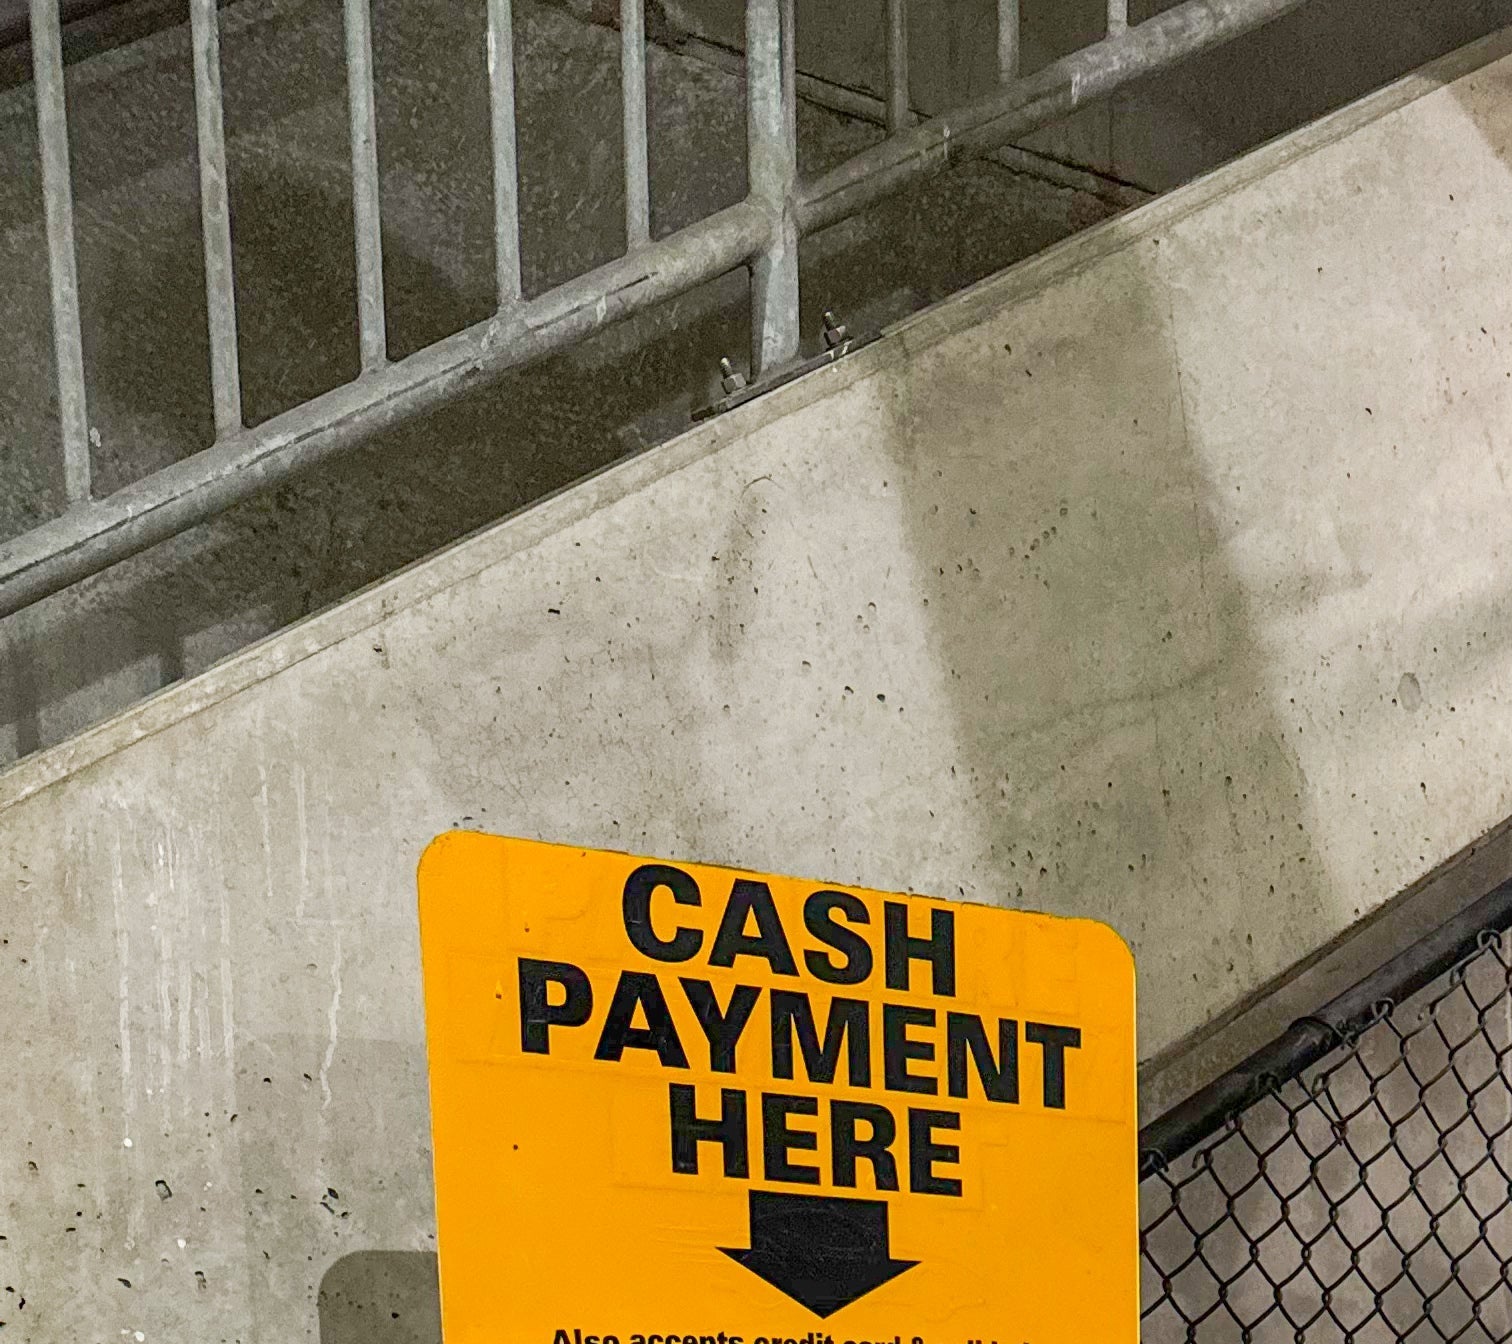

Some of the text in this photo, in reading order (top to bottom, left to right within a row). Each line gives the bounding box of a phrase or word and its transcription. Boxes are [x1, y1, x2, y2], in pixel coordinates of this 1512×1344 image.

[622, 864, 955, 997] CASH
[517, 958, 1082, 1109] PAYMENT
[668, 1084, 963, 1197] HERE
